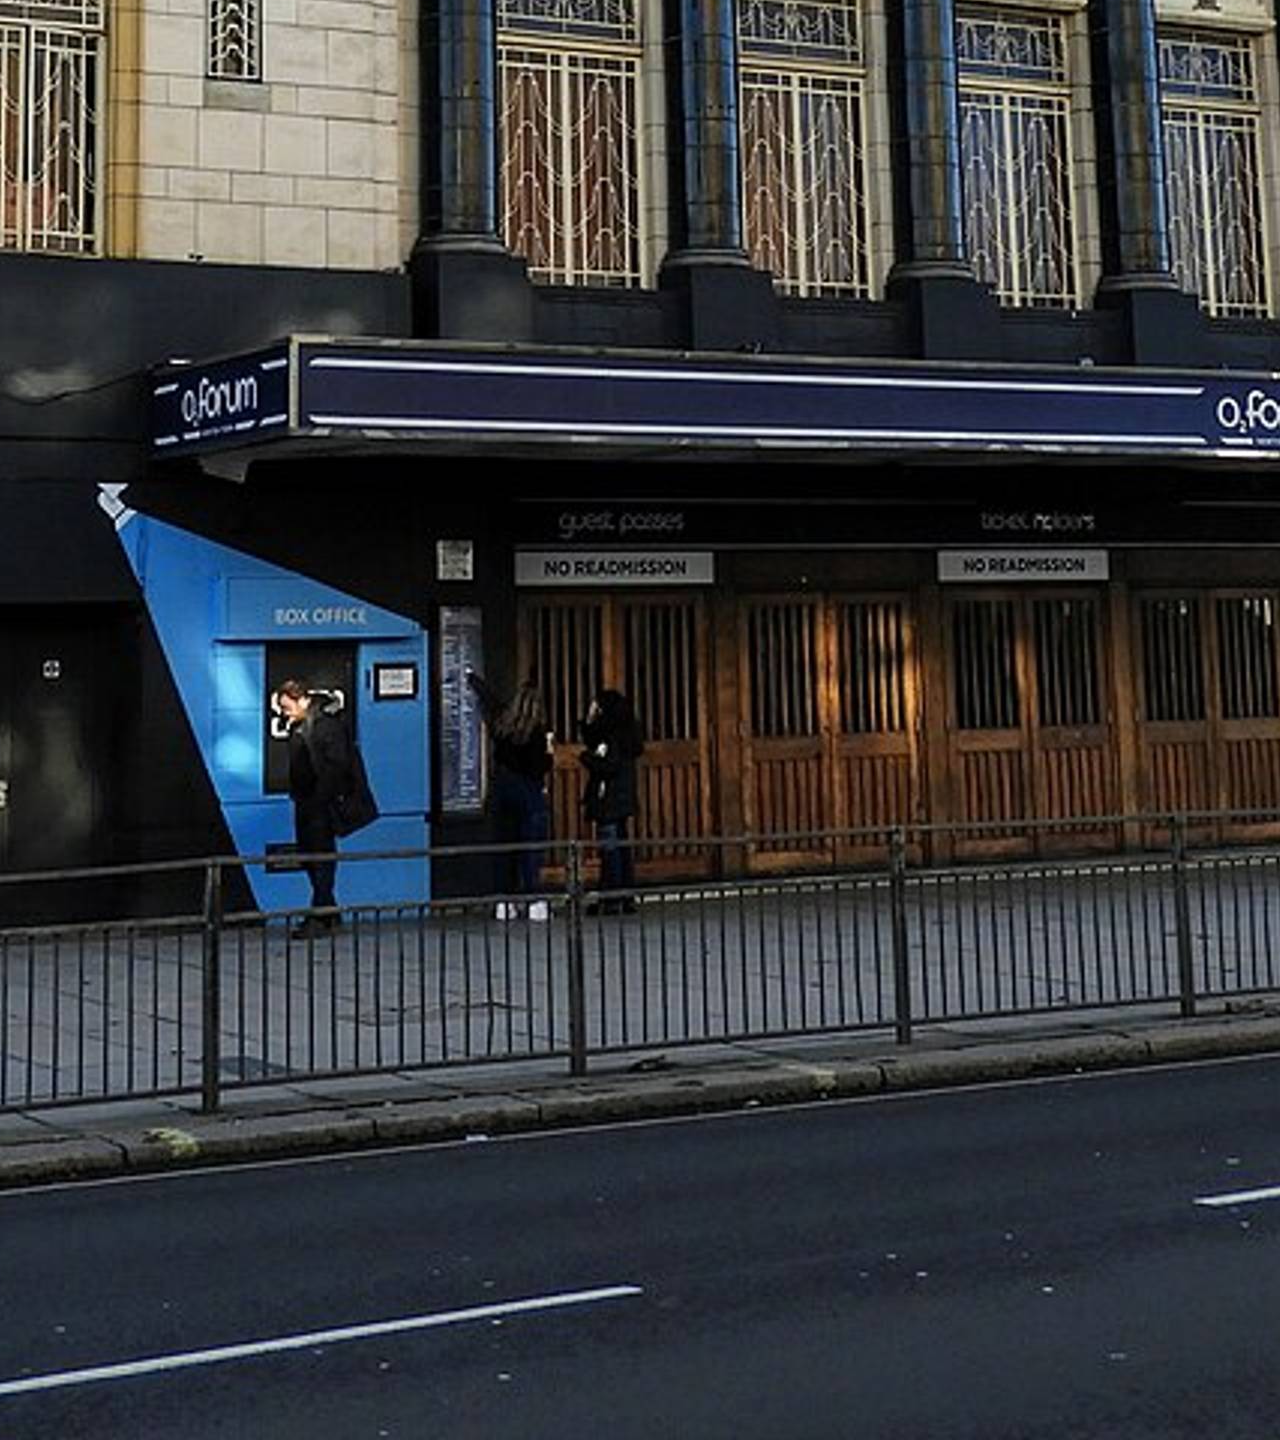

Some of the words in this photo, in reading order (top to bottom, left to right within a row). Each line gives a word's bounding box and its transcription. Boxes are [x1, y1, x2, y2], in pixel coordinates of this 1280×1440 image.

[559, 511, 615, 539] guest
[544, 560, 570, 576] NO
[574, 559, 687, 576] READMISSION
[963, 558, 986, 573] NO
[988, 557, 1086, 573] READMISSION
[274, 608, 309, 625] BOX
[312, 608, 368, 625] OFFICE
